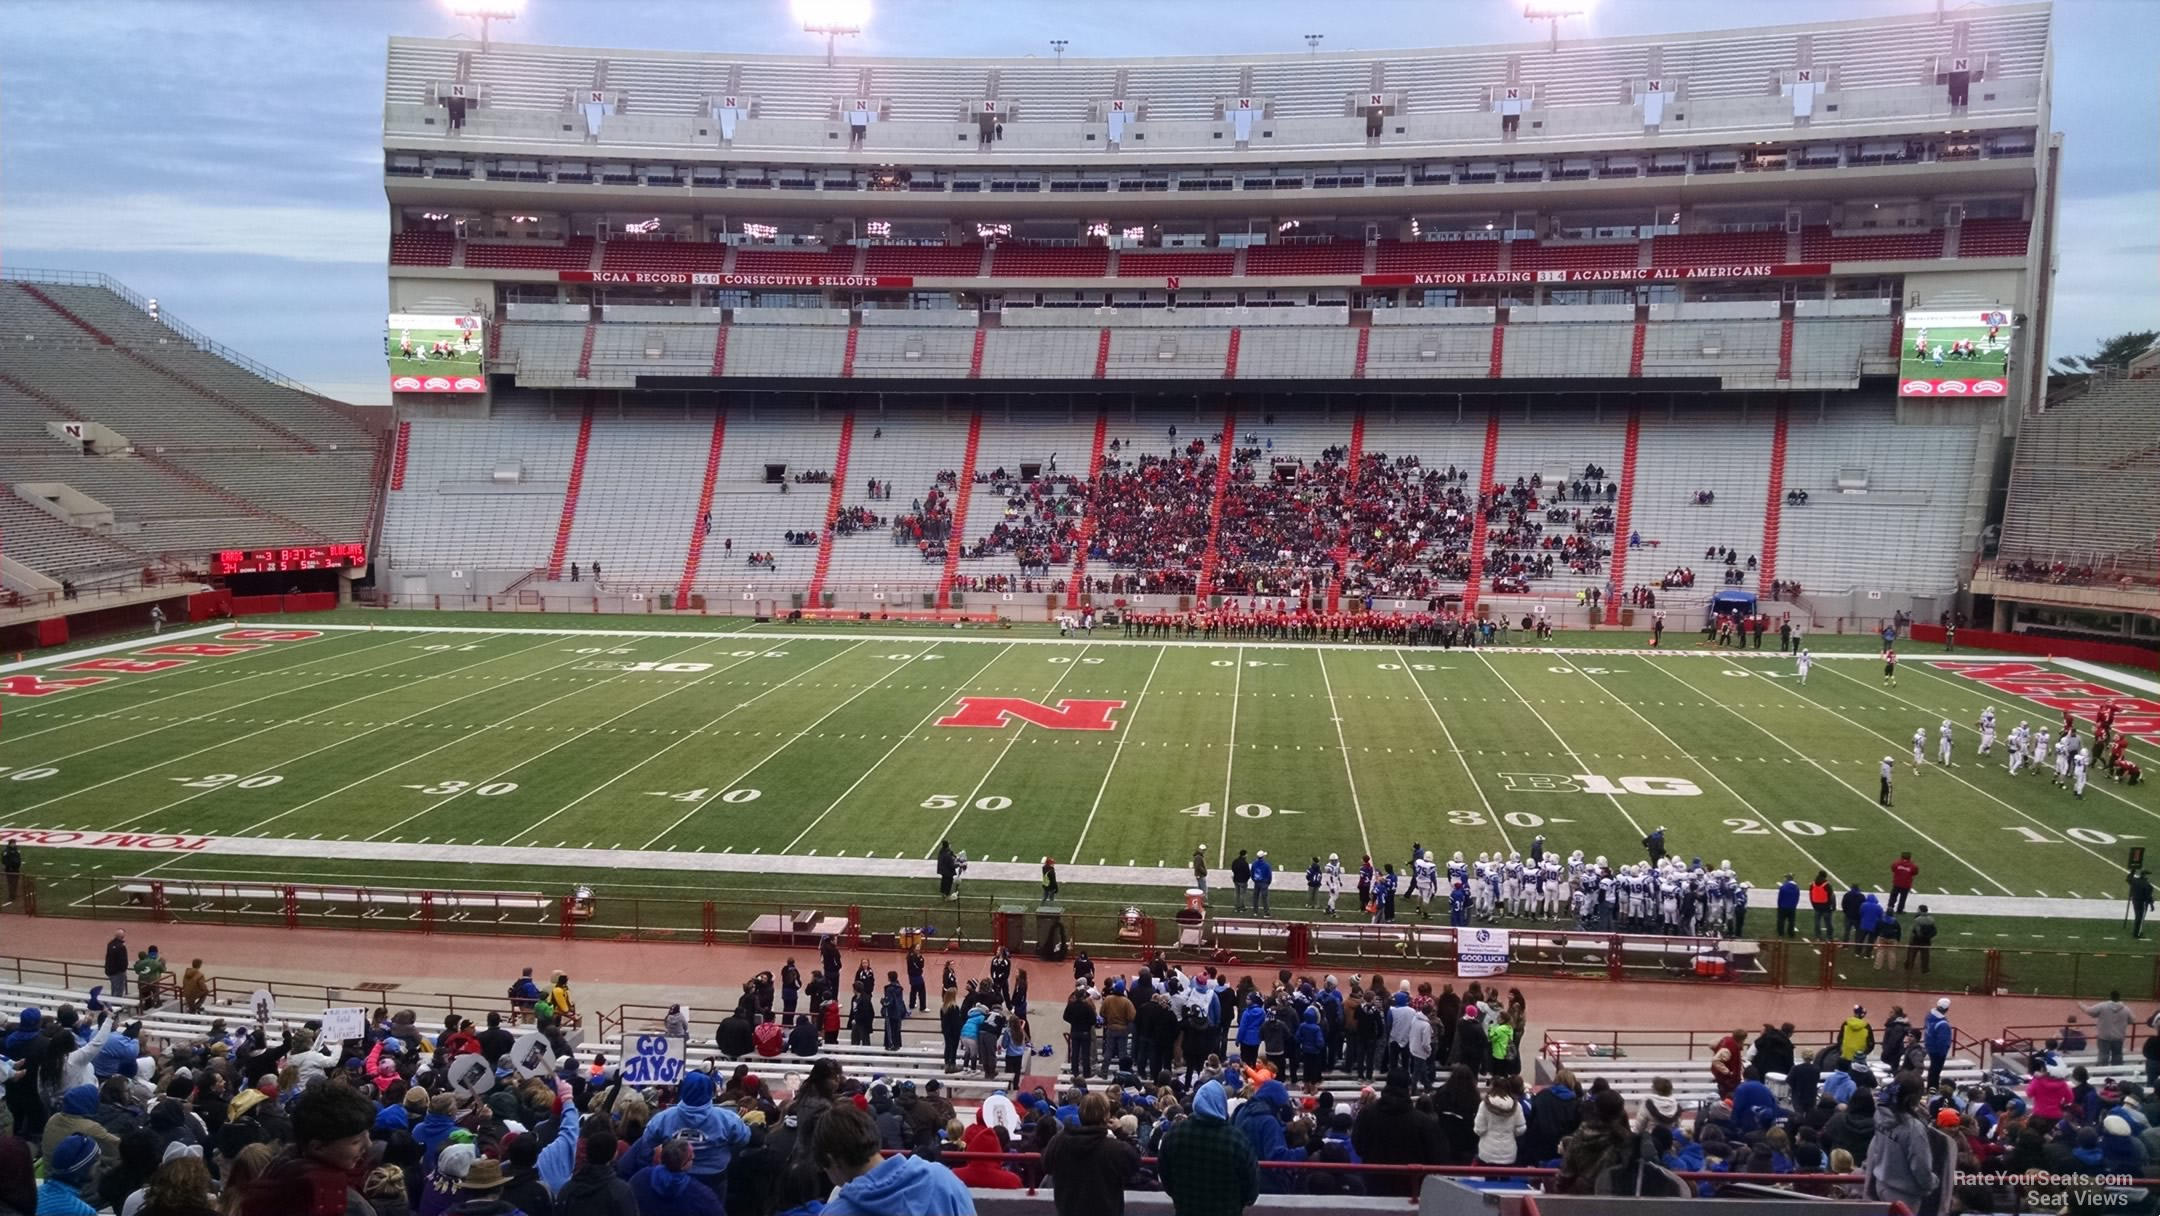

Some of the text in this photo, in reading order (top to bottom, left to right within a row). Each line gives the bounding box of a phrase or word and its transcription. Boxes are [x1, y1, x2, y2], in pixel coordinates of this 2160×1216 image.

[1955, 60, 1967, 70] N
[1799, 71, 1809, 81] N
[454, 86, 463, 95] N
[1649, 81, 1659, 91] N
[592, 93, 601, 102] N
[1372, 95, 1381, 104] N
[1507, 89, 1517, 98] N
[726, 98, 735, 106] N
[857, 101, 866, 109] N
[985, 102, 994, 111] N
[1114, 102, 1122, 110] N
[1240, 99, 1249, 108] N
[593, 273, 878, 286] NCAA RECORD 340 CONSECUTIVE SELLOUTS
[1415, 266, 1772, 285] NATION LEADING 314 ACADEMIC ALL AMERICANS
[1167, 277, 1179, 289] N
[65, 425, 80, 438] N
[281, 550, 306, 561] 8:37
[330, 545, 362, 556] BLUEJAYS
[932, 696, 1127, 731] N
[181, 773, 284, 788] 20
[421, 781, 519, 796] 30
[669, 787, 762, 803] 40
[919, 794, 1013, 811] 50
[1179, 802, 1273, 819] 40
[1446, 810, 1545, 828] 30
[1721, 818, 1827, 836] 20
[84, 834, 215, 849] TOM
[2000, 826, 2118, 845] 10
[1631, 884, 1642, 894] 19
[636, 1035, 668, 1055] GO
[623, 1056, 685, 1084] JAYS!
